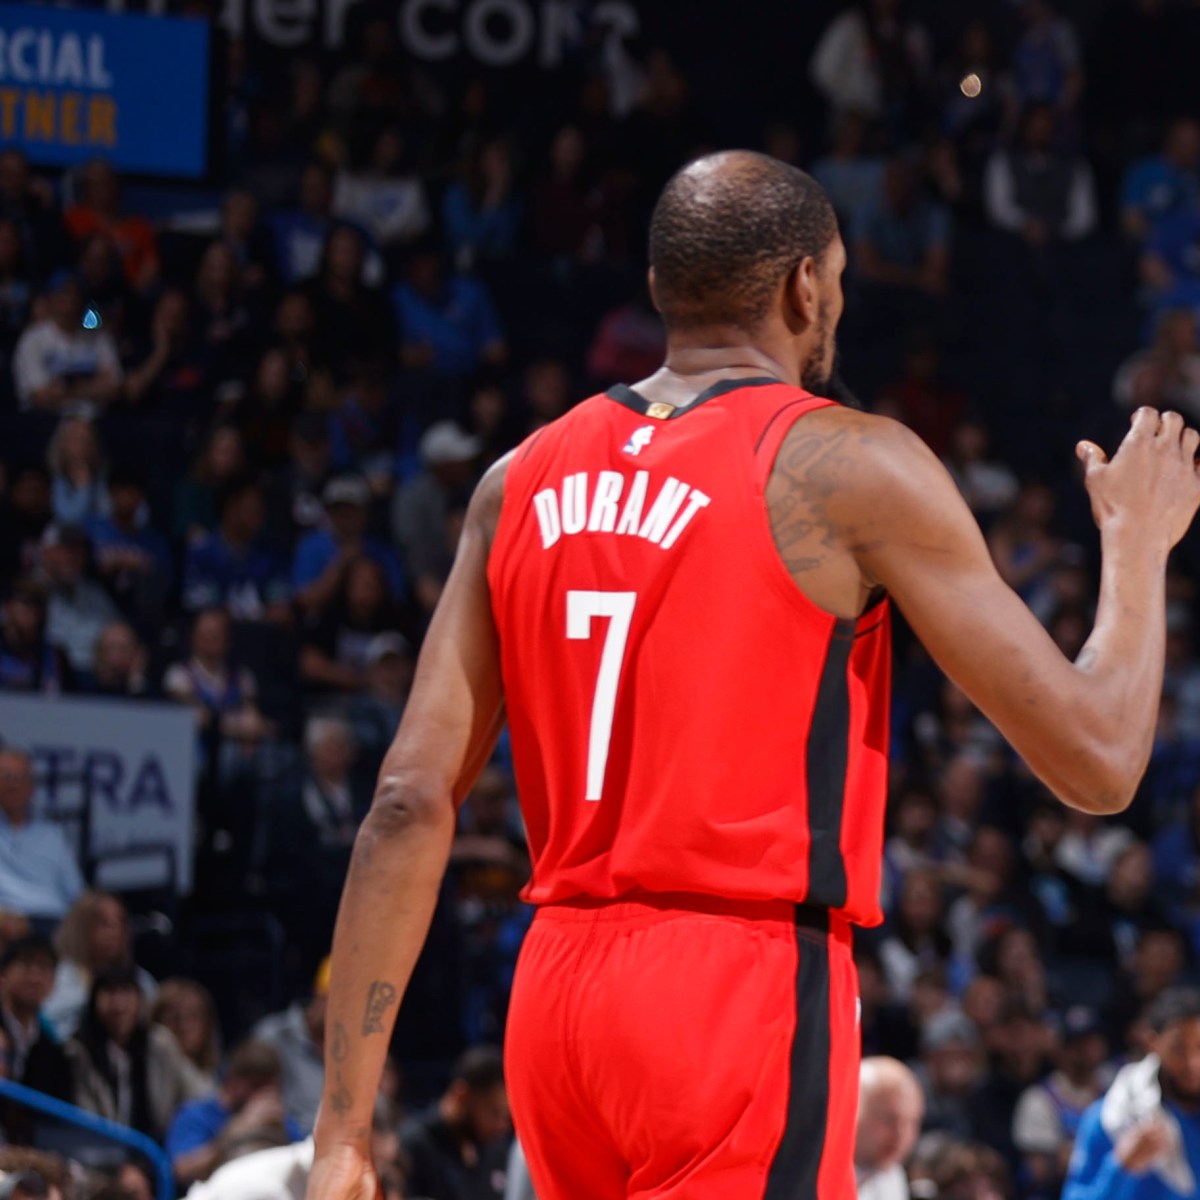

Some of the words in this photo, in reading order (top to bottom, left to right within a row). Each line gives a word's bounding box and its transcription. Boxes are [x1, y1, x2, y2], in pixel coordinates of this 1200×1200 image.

[0, 23, 114, 90] CIAL
[533, 470, 712, 550] DURANT
[566, 590, 637, 801] 7
